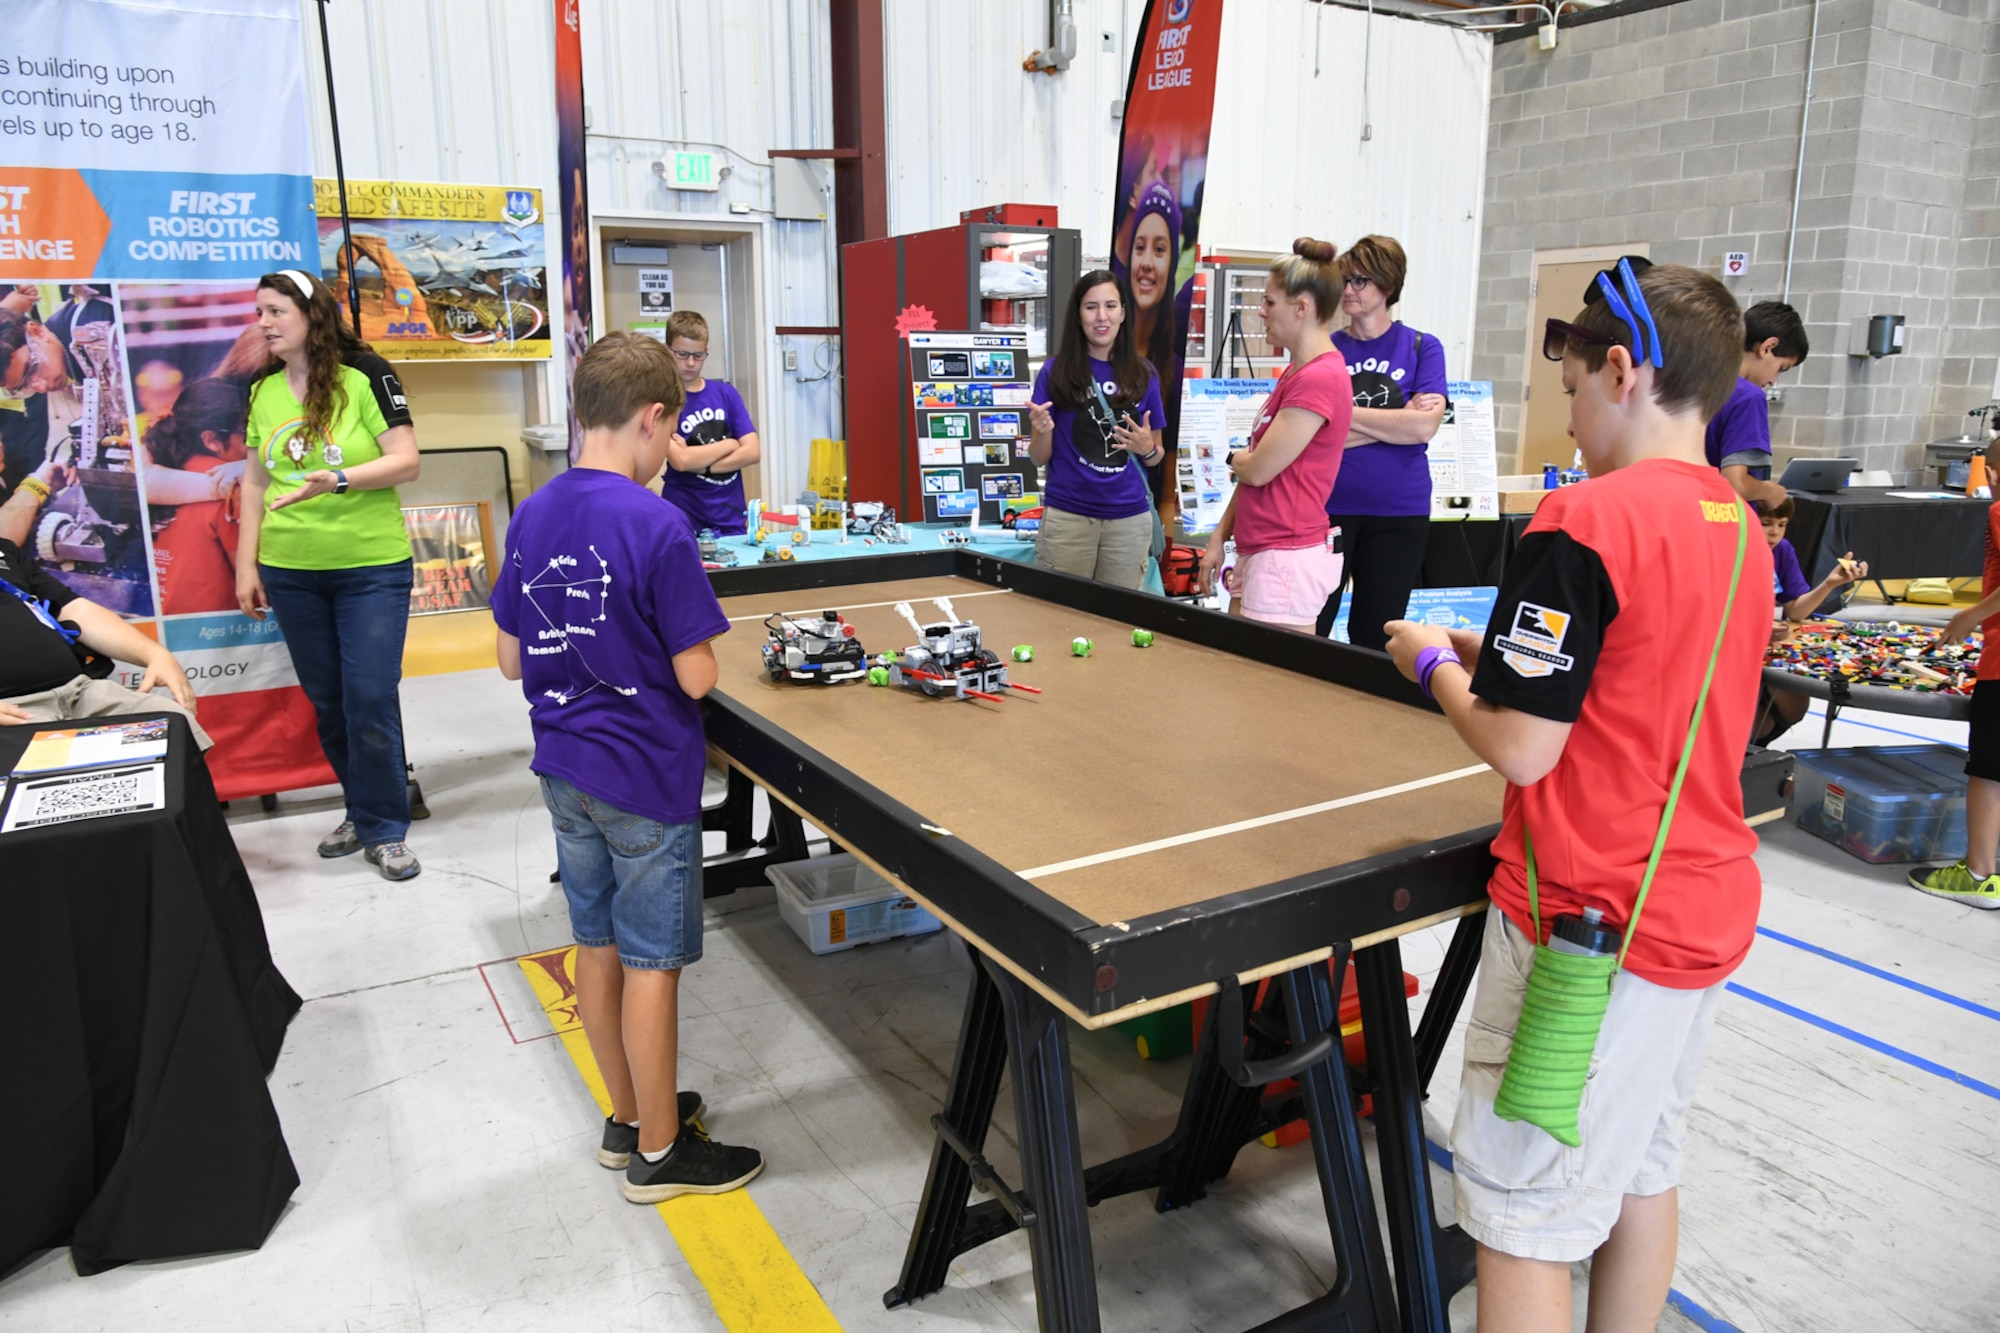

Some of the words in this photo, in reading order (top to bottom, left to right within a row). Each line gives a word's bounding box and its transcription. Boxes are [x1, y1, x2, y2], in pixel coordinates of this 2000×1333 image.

[18, 56, 108, 86] building
[117, 66, 174, 86] upon
[2, 88, 122, 115] continuing
[129, 92, 216, 118] through
[0, 115, 36, 135] els
[44, 121, 73, 141] up
[80, 118, 103, 138] to
[111, 123, 153, 144] age
[162, 122, 197, 142] 18.
[676, 153, 711, 184] EXIT
[371, 185, 485, 200] COMMANDER'S
[169, 190, 256, 215] FIRST
[380, 197, 435, 217] SAFE
[439, 199, 487, 218] SITE
[148, 216, 280, 239] ROBOTICS
[128, 240, 302, 261] COMPETITION
[388, 322, 427, 334] AFGE
[446, 314, 477, 329] VPP
[903, 320, 930, 330] Project
[1391, 368, 1406, 381] 8
[423, 566, 466, 582] BEST
[425, 578, 472, 595] TEAM
[1446, 589, 1472, 598] Analysis
[418, 593, 461, 609] USAF
[199, 625, 225, 641] Ages
[229, 621, 261, 636] 14-18
[1515, 630, 1557, 646] OVERWATCH
[1499, 640, 1536, 657] INAUGURAL
[1537, 652, 1567, 666] SEASON
[1513, 635, 1556, 653] LEAGUE
